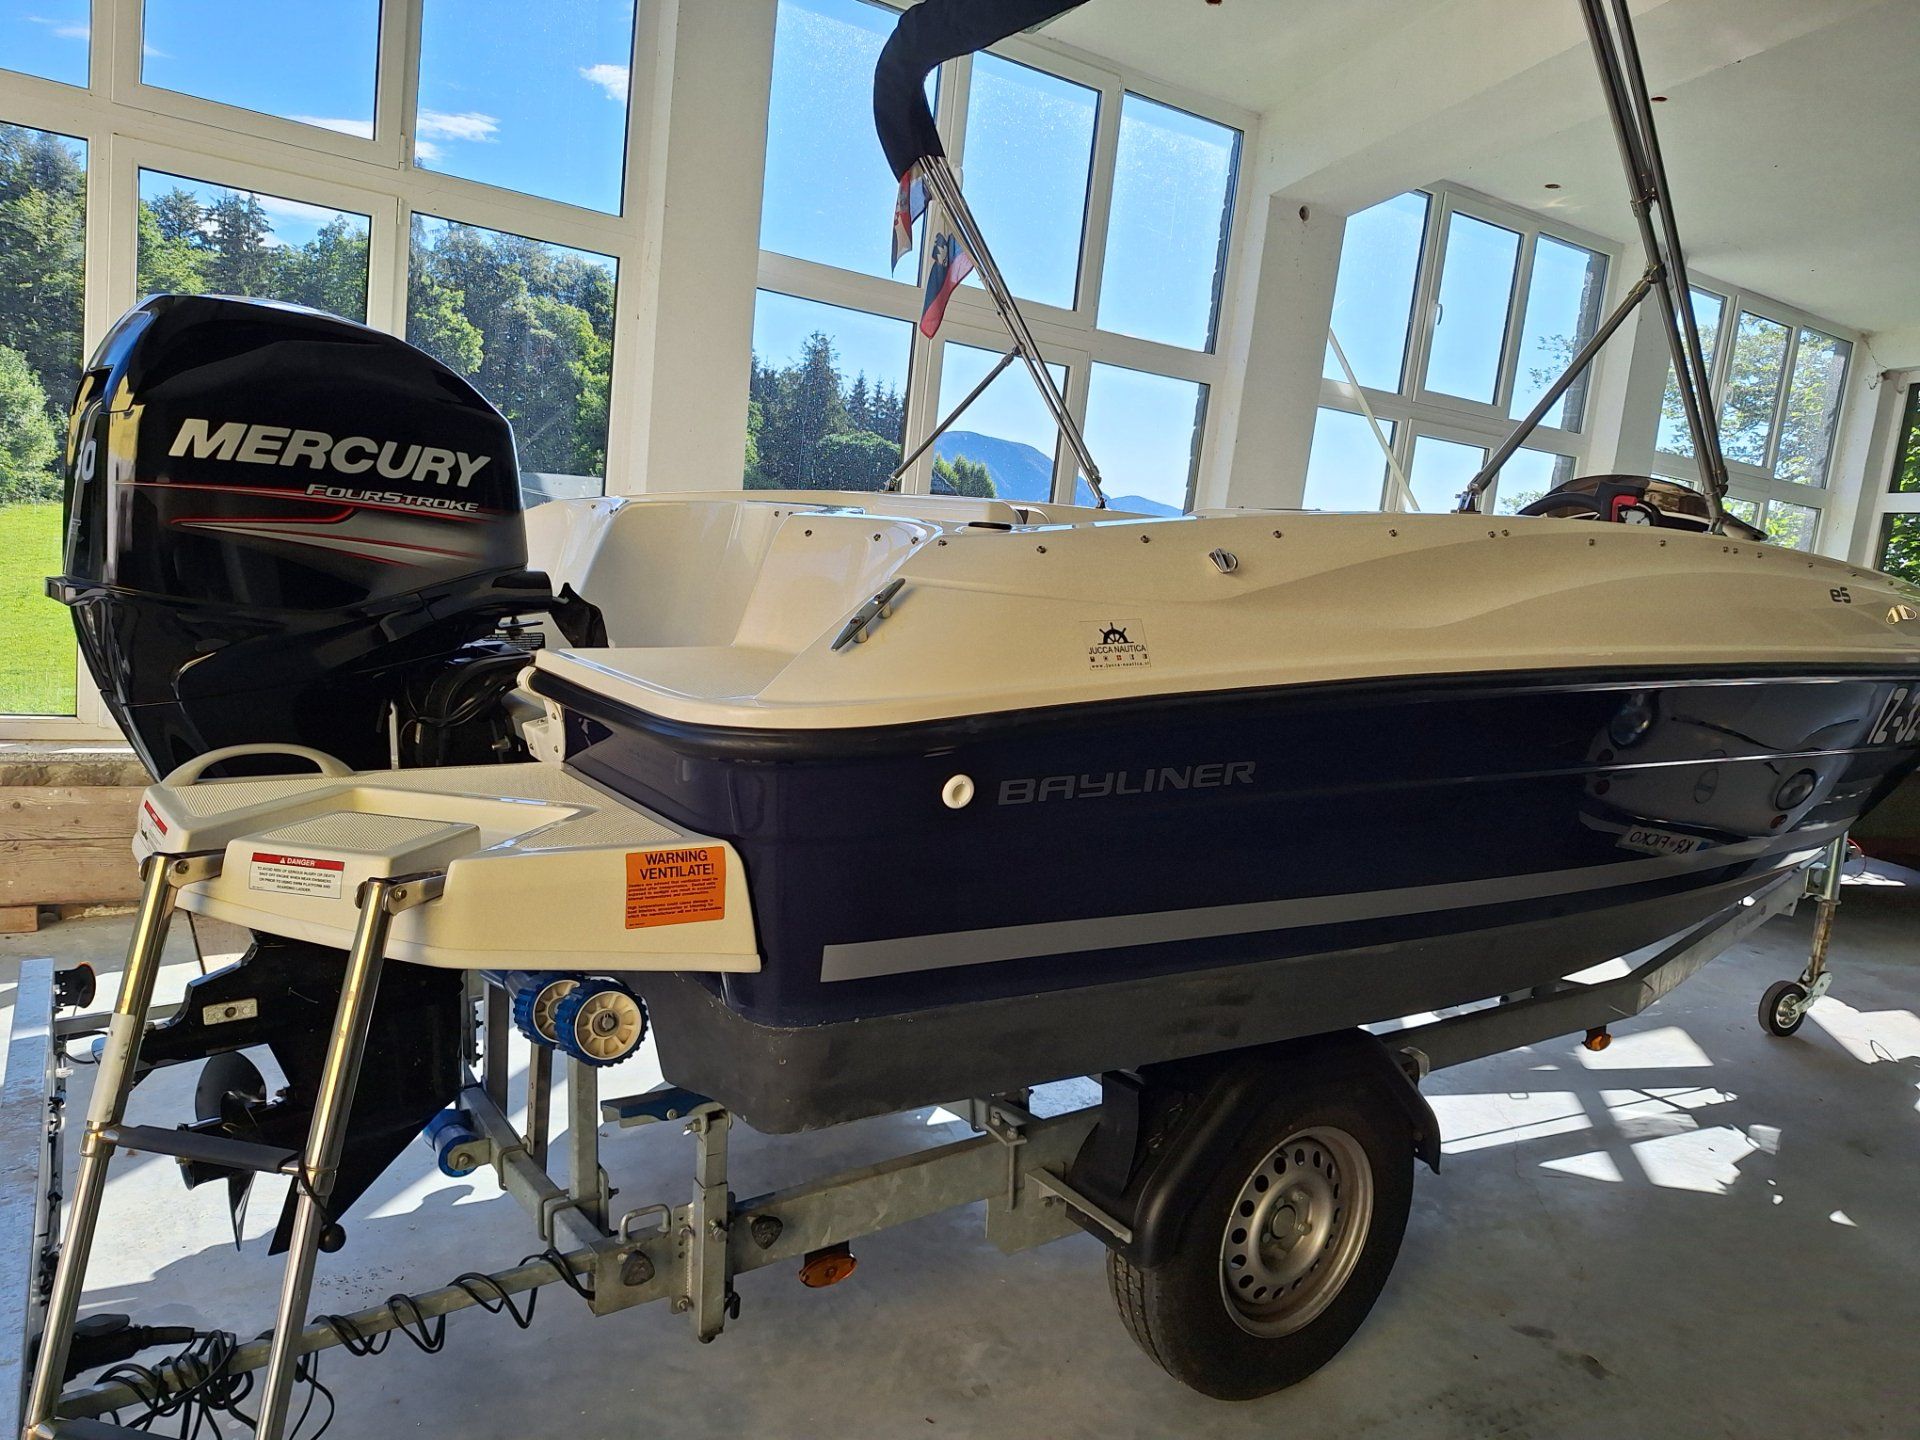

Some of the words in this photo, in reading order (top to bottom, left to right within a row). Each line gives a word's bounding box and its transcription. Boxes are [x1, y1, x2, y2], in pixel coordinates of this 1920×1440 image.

[168, 418, 491, 487] MERCURY
[305, 483, 480, 513] FOURSTROKE
[1088, 646, 1113, 655] JUCCA
[1113, 644, 1147, 654] NAUTICA
[997, 760, 1256, 806] BAYLINER
[287, 858, 316, 866] DANGER
[645, 849, 708, 866] WARNING
[639, 863, 715, 880] VENTILATE!
